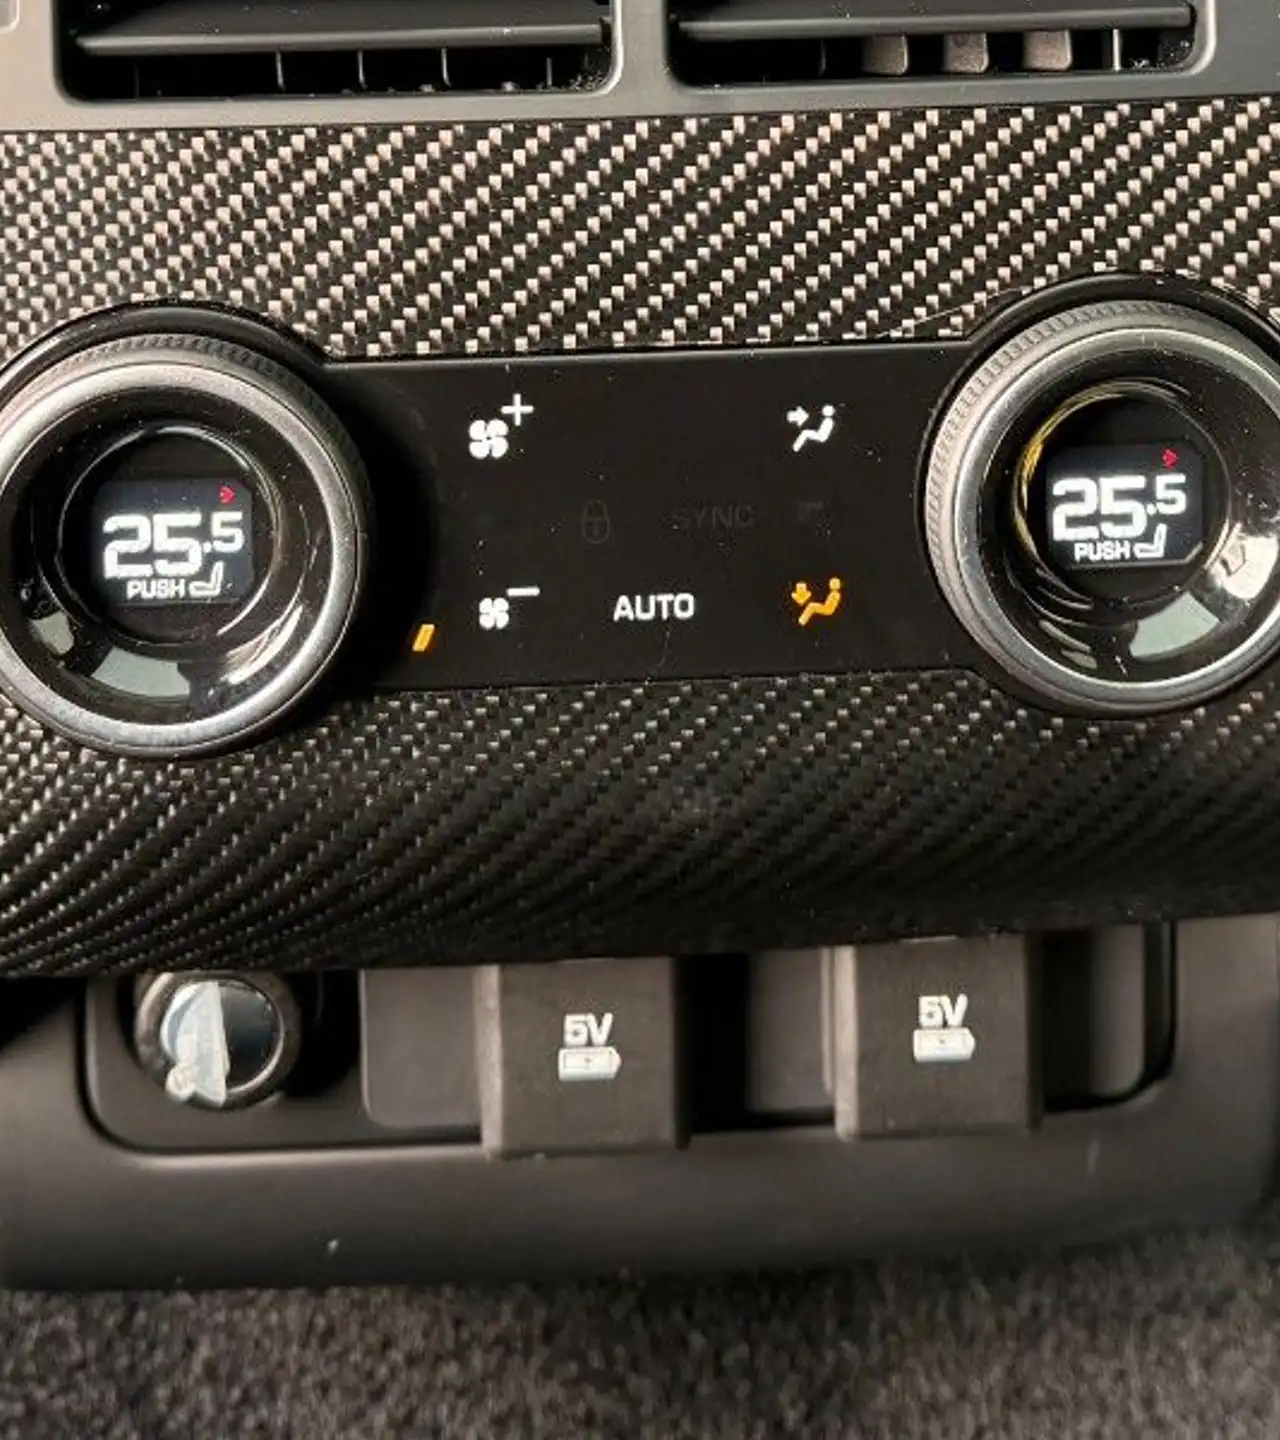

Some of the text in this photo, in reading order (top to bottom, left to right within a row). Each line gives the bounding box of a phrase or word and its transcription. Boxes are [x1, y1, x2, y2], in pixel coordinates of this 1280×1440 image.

[1052, 474, 1186, 540] 25.5
[103, 511, 244, 579] 25.5
[1074, 541, 1131, 561] PUSH
[126, 580, 186, 599] PUSH
[613, 593, 694, 621] AUTO
[918, 995, 968, 1028] 5V
[564, 1013, 615, 1046] 5V
